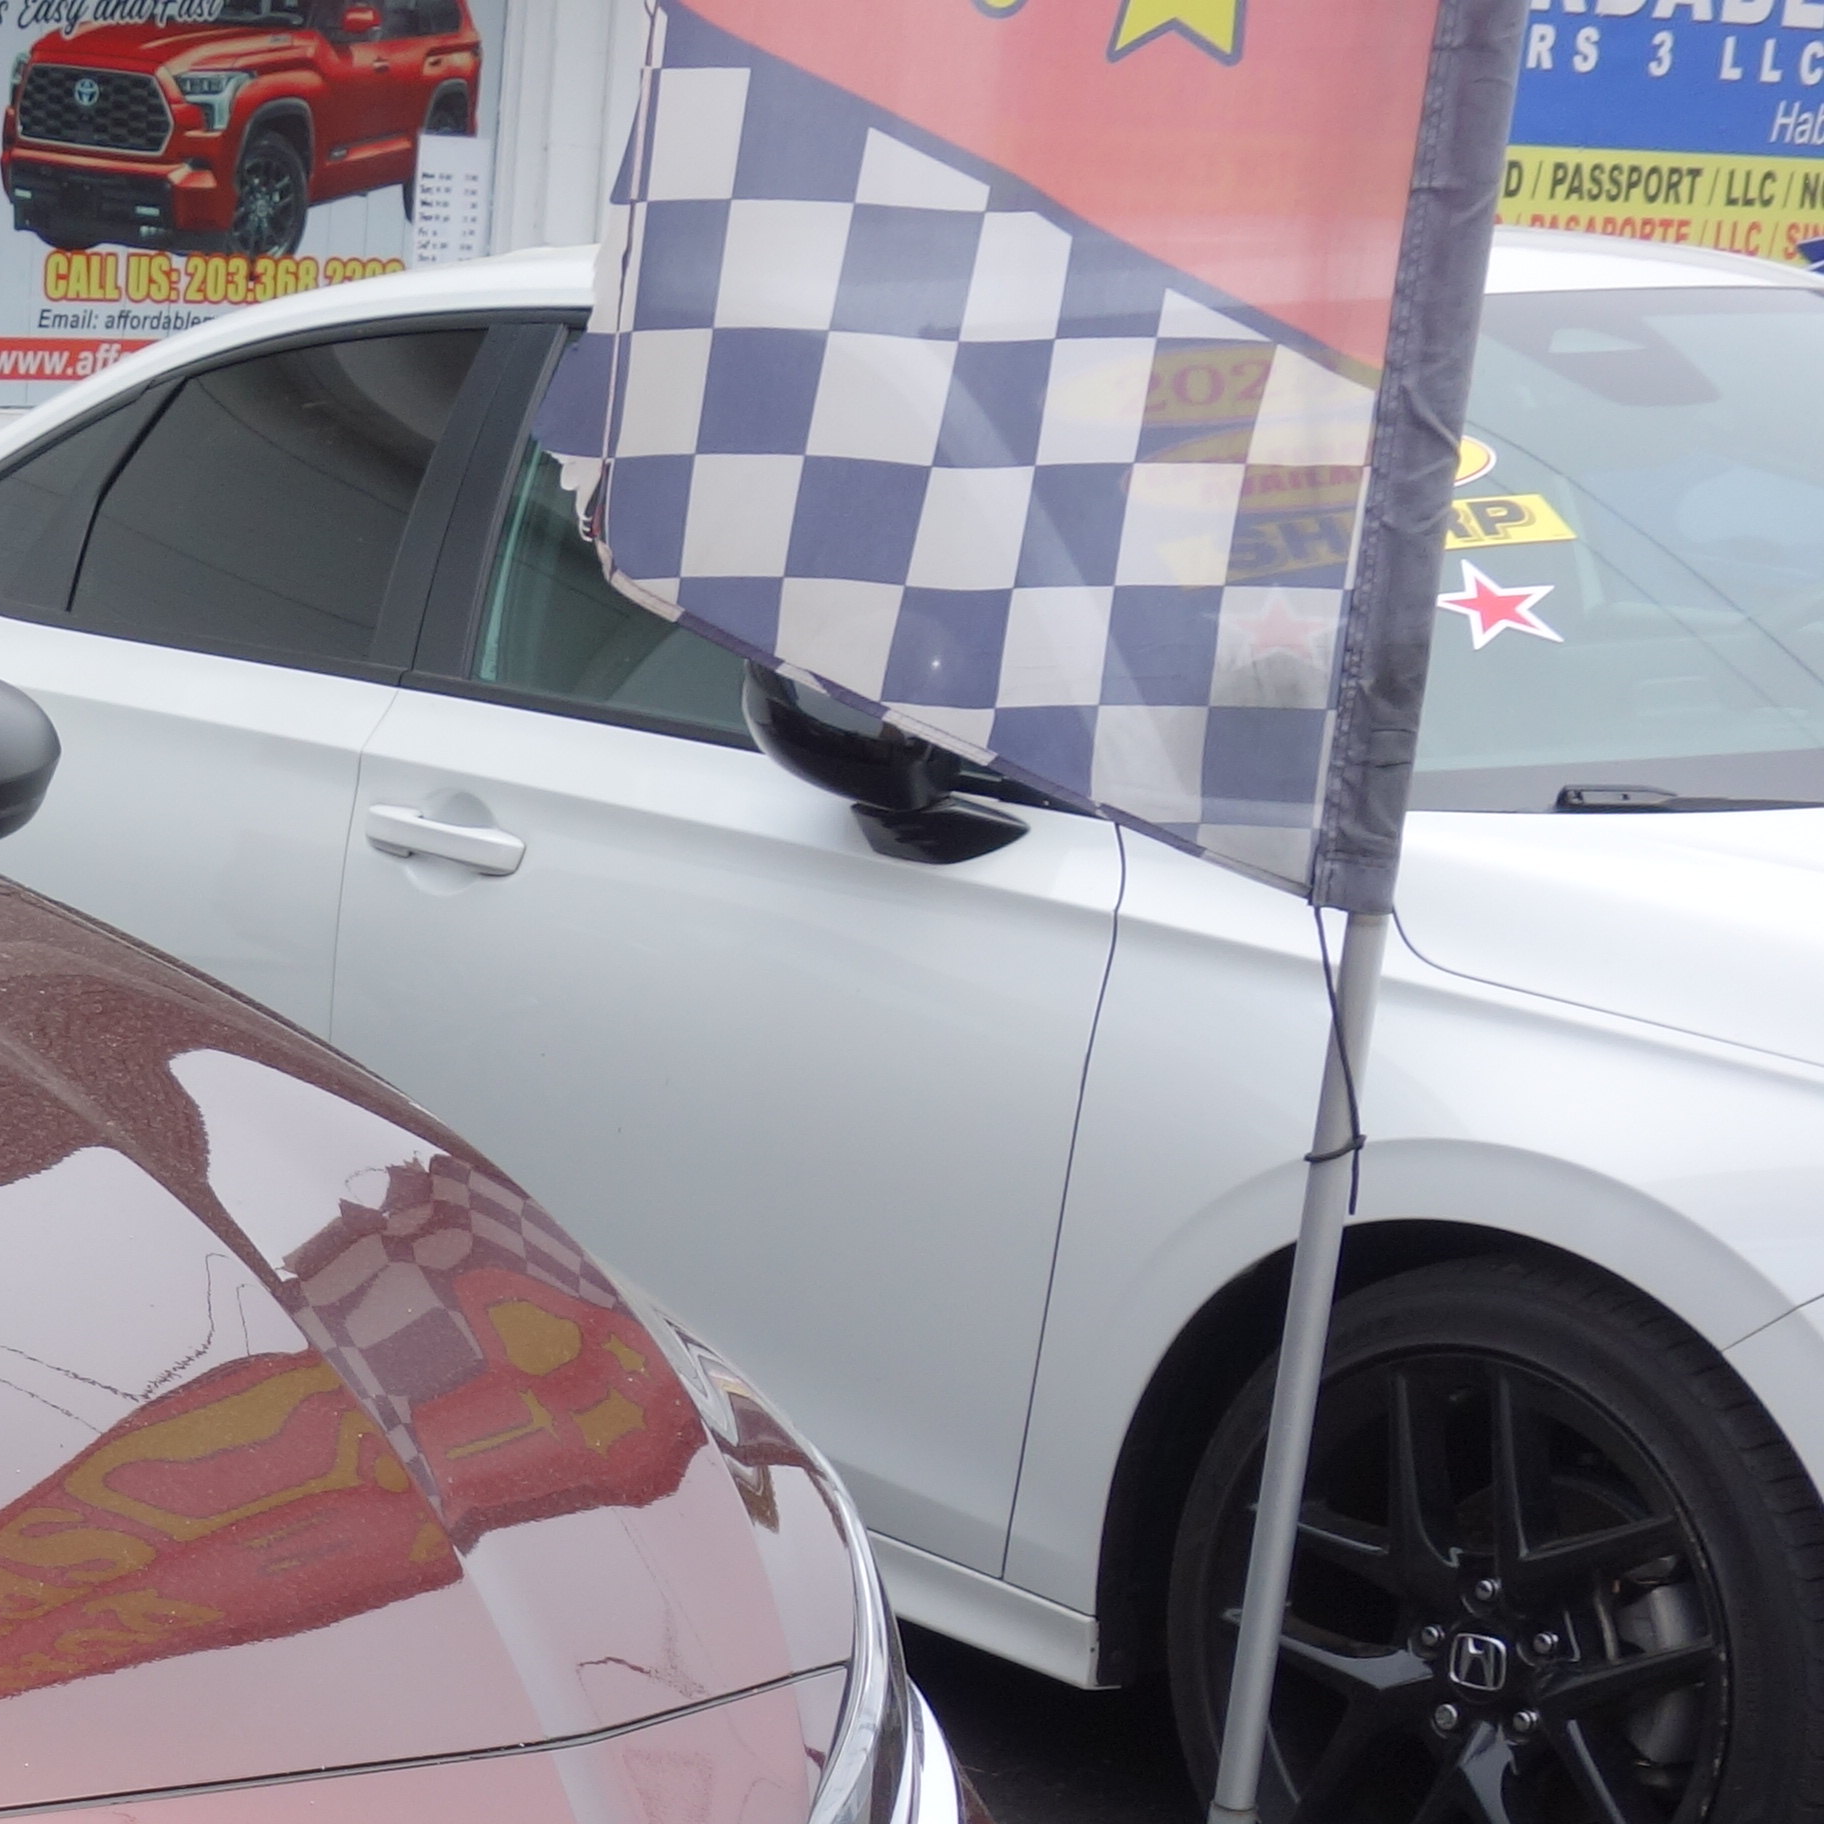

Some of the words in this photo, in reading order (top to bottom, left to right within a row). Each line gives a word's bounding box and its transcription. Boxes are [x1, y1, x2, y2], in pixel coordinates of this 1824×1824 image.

[1648, 30, 1674, 77] 3
[1718, 36, 1824, 86] LLC
[1550, 162, 1703, 205] PASSPORT
[1725, 168, 1777, 207] LLC
[1713, 220, 1762, 256] LLC
[45, 250, 121, 301] CALL
[126, 252, 180, 303] US:
[37, 308, 99, 330] Email:
